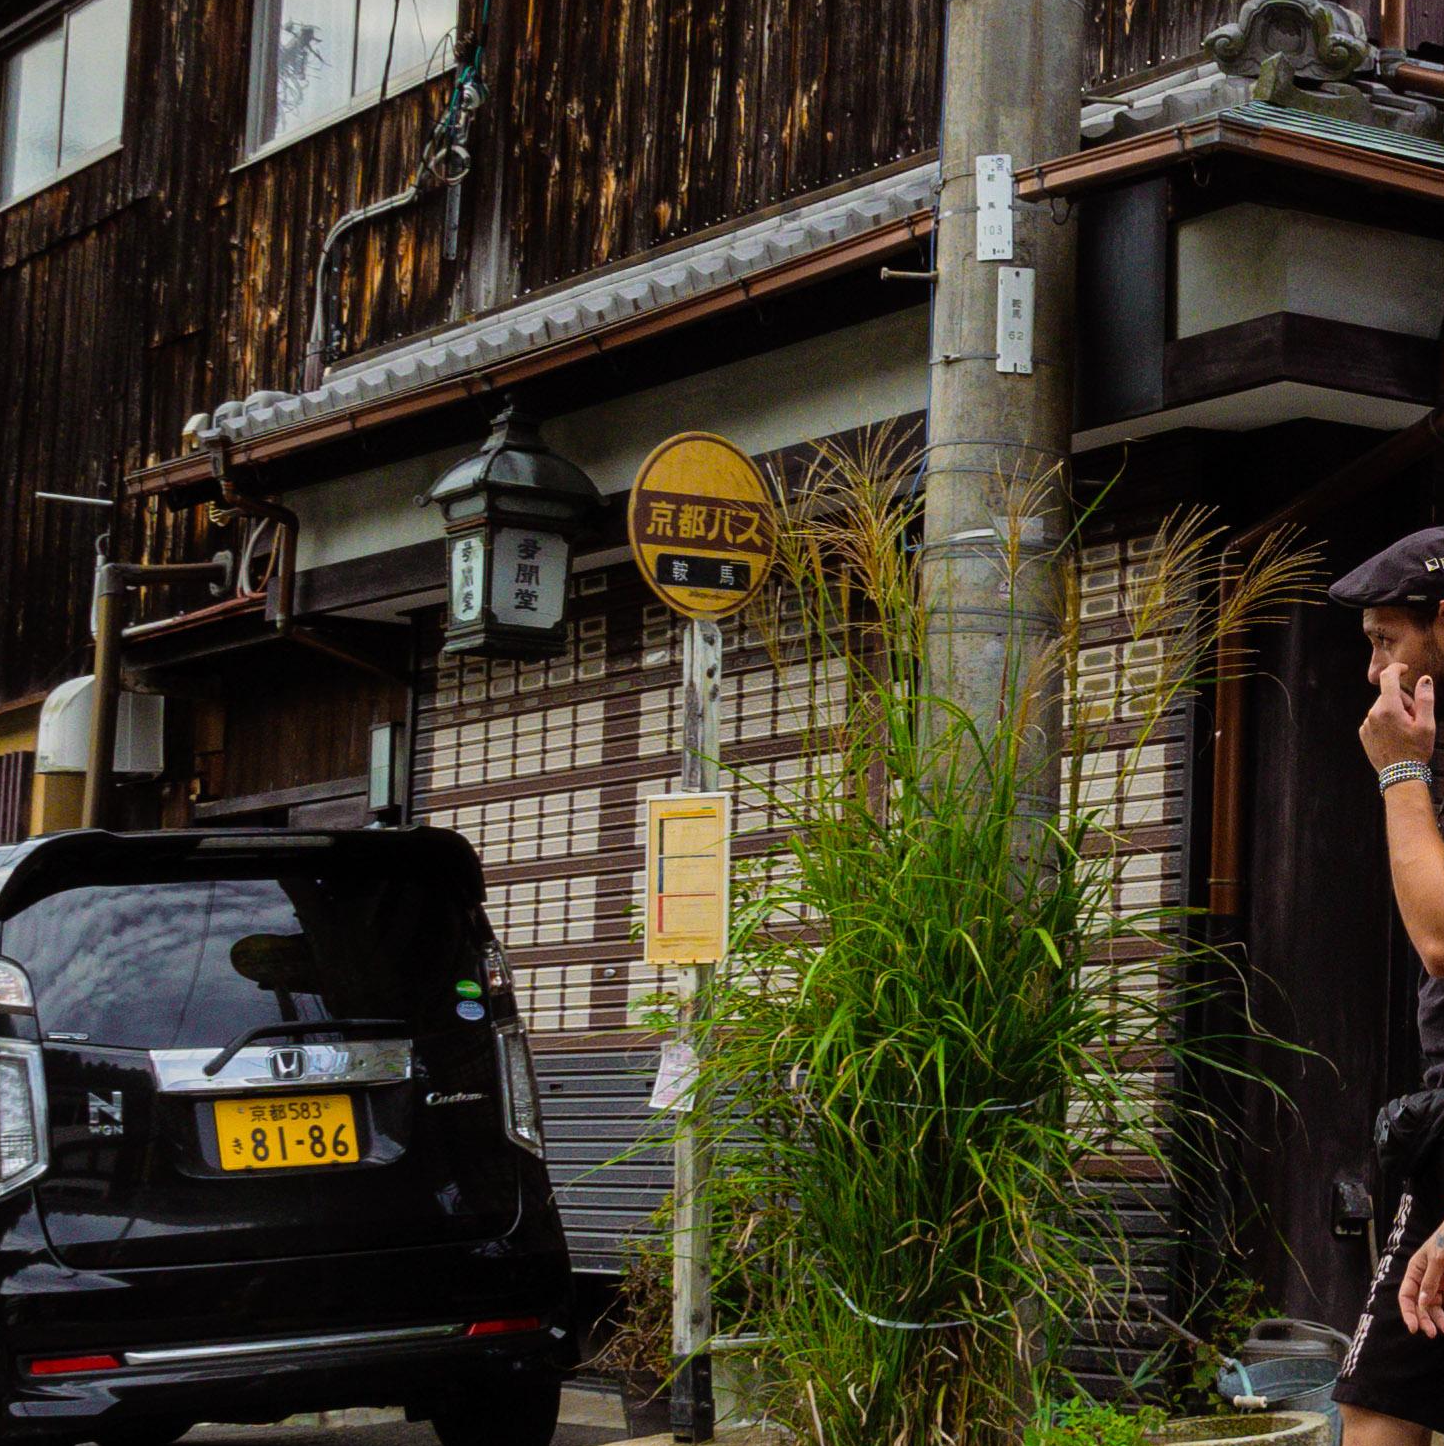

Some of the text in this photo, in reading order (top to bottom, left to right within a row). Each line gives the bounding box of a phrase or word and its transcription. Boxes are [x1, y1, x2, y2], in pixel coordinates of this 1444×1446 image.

[1008, 331, 1024, 341] 62
[646, 501, 763, 547] 京都バス
[672, 560, 734, 586] 鞍馬
[425, 1092, 489, 1105] Custom
[251, 1124, 349, 1162] 81-86
